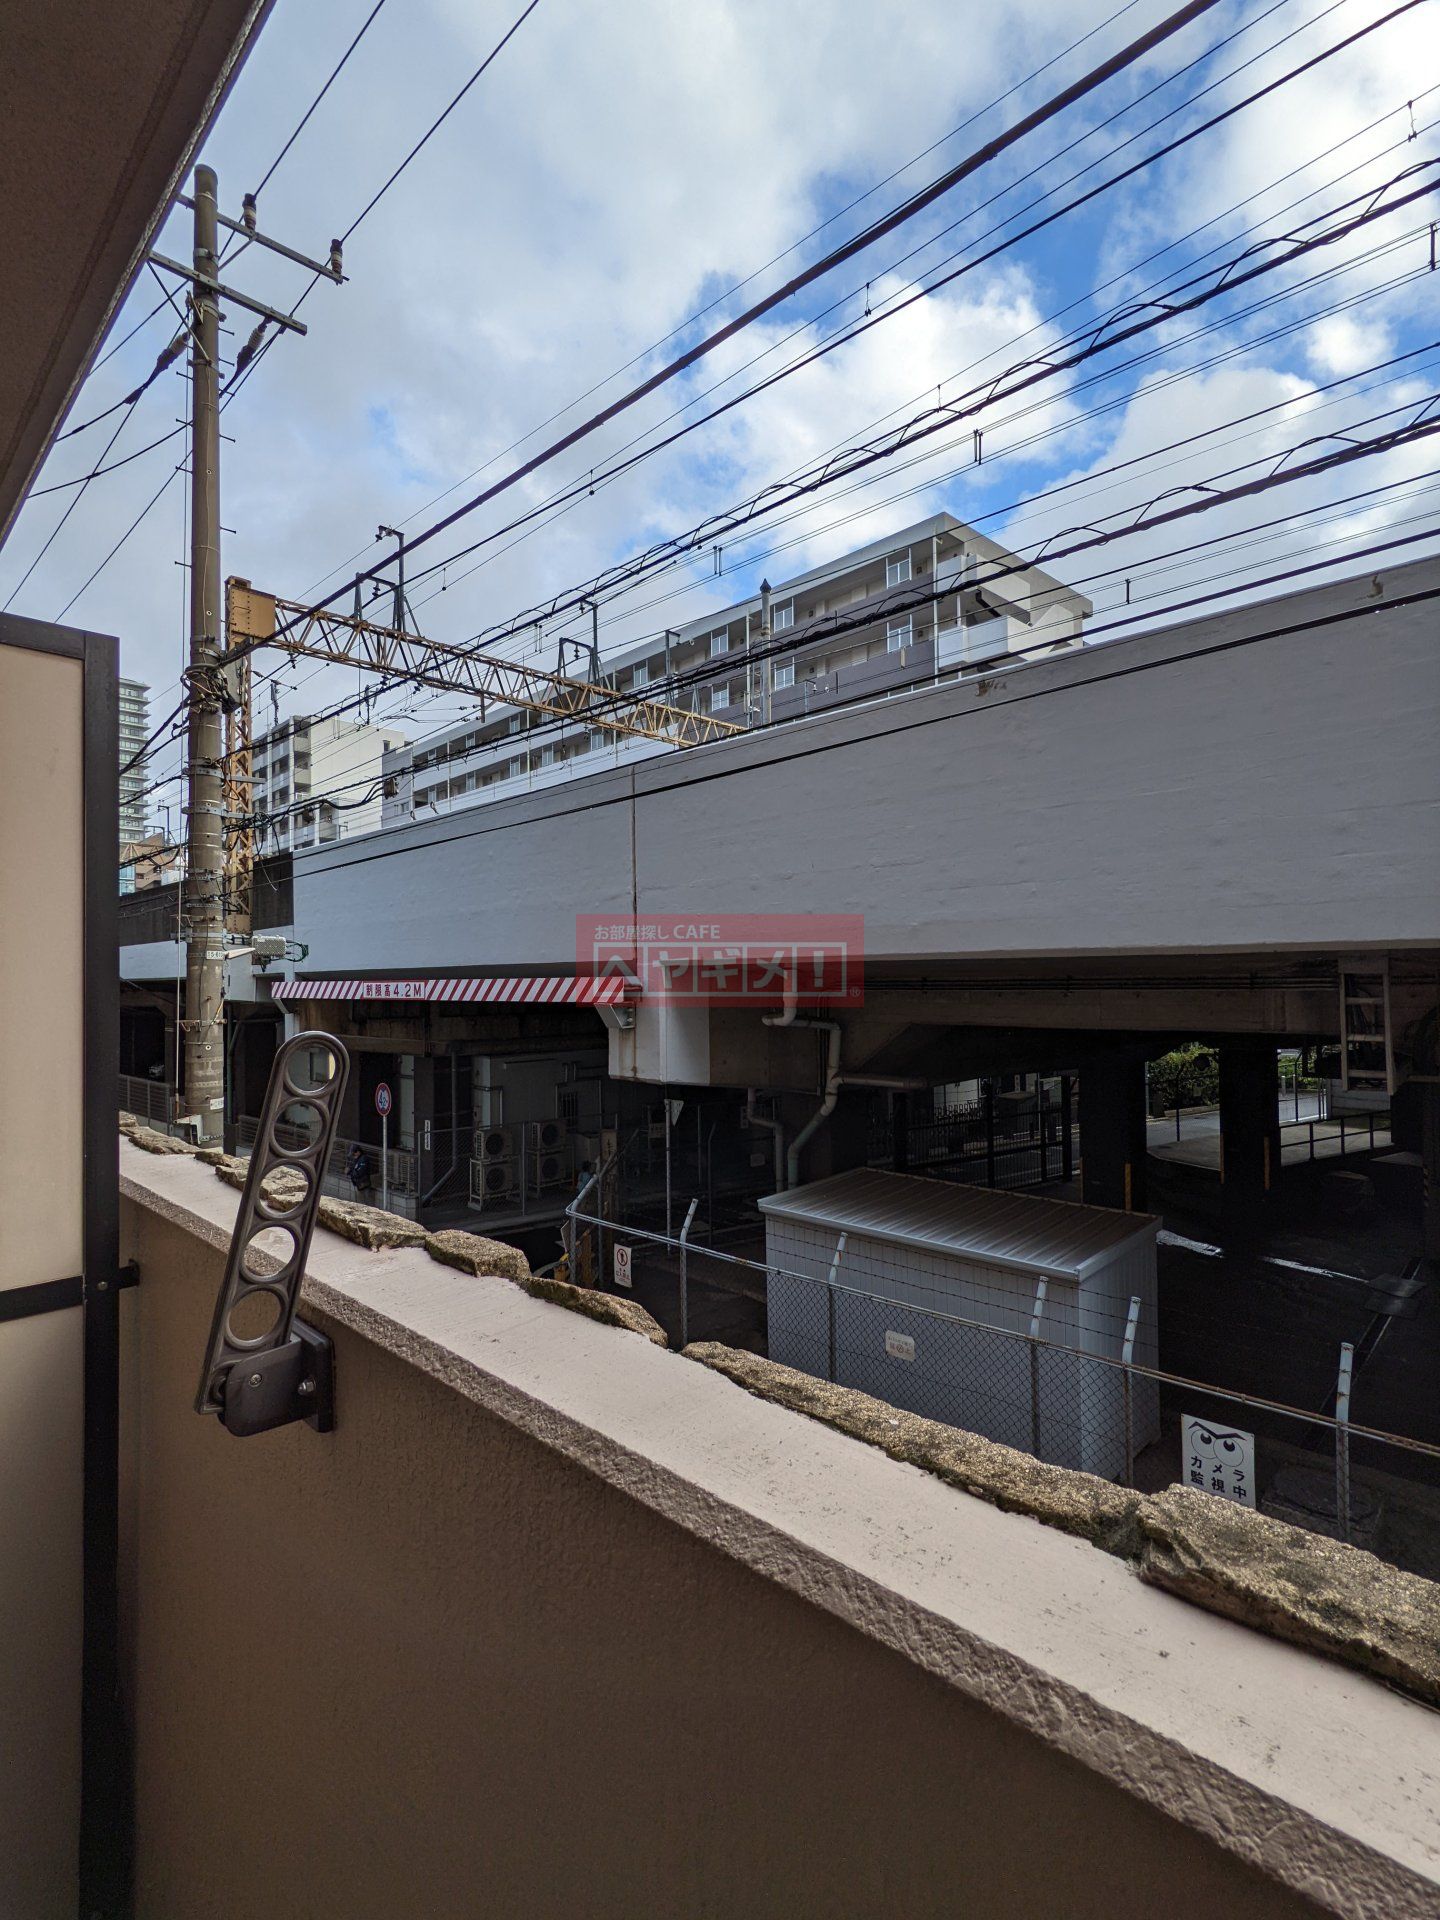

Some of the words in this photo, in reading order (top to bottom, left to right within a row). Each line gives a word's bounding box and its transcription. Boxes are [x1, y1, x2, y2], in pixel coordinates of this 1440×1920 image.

[1190, 1455, 1245, 1482] カメラ
[1190, 1470, 1247, 1498] 監視中
